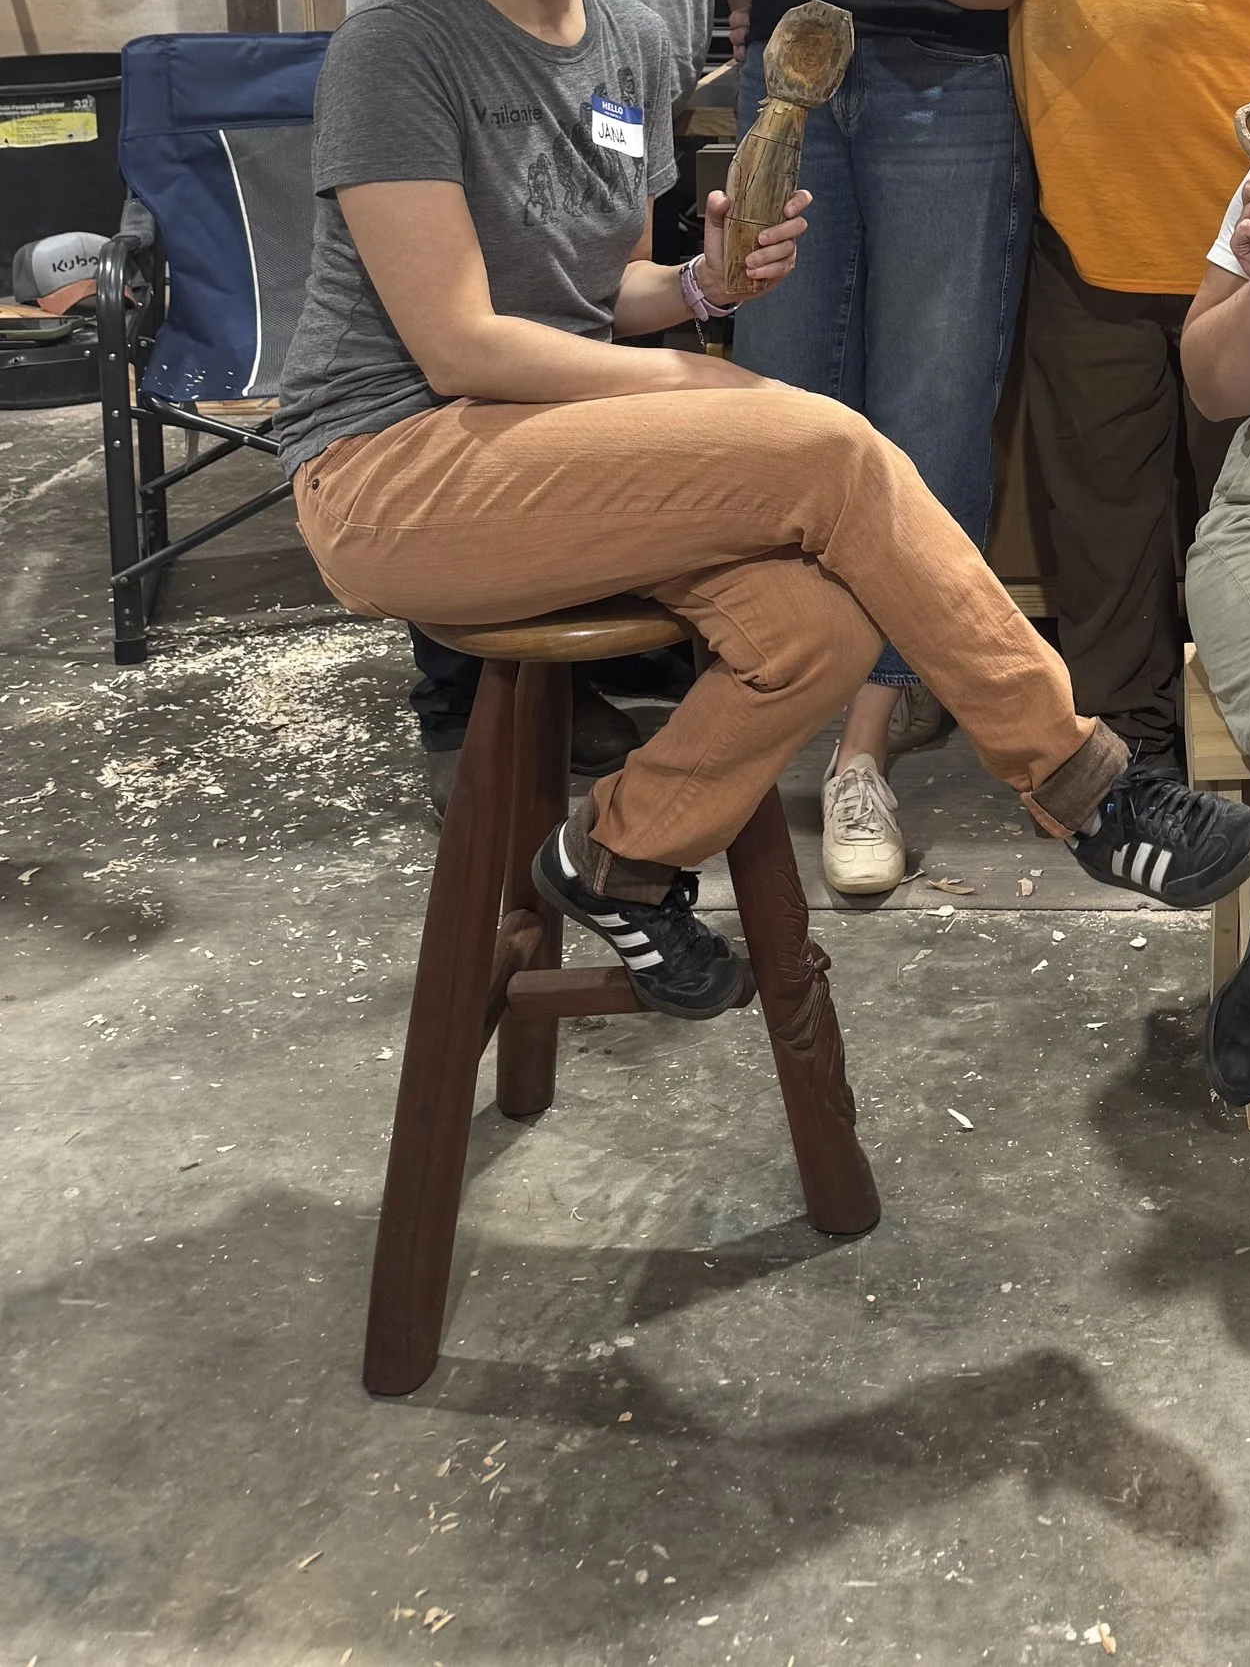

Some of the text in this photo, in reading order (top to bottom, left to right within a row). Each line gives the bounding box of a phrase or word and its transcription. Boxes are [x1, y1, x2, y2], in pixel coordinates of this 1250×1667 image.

[470, 98, 543, 130] Vgilante
[602, 101, 623, 114] HELLO
[598, 122, 627, 145] JANA
[52, 255, 99, 273] Kubo
